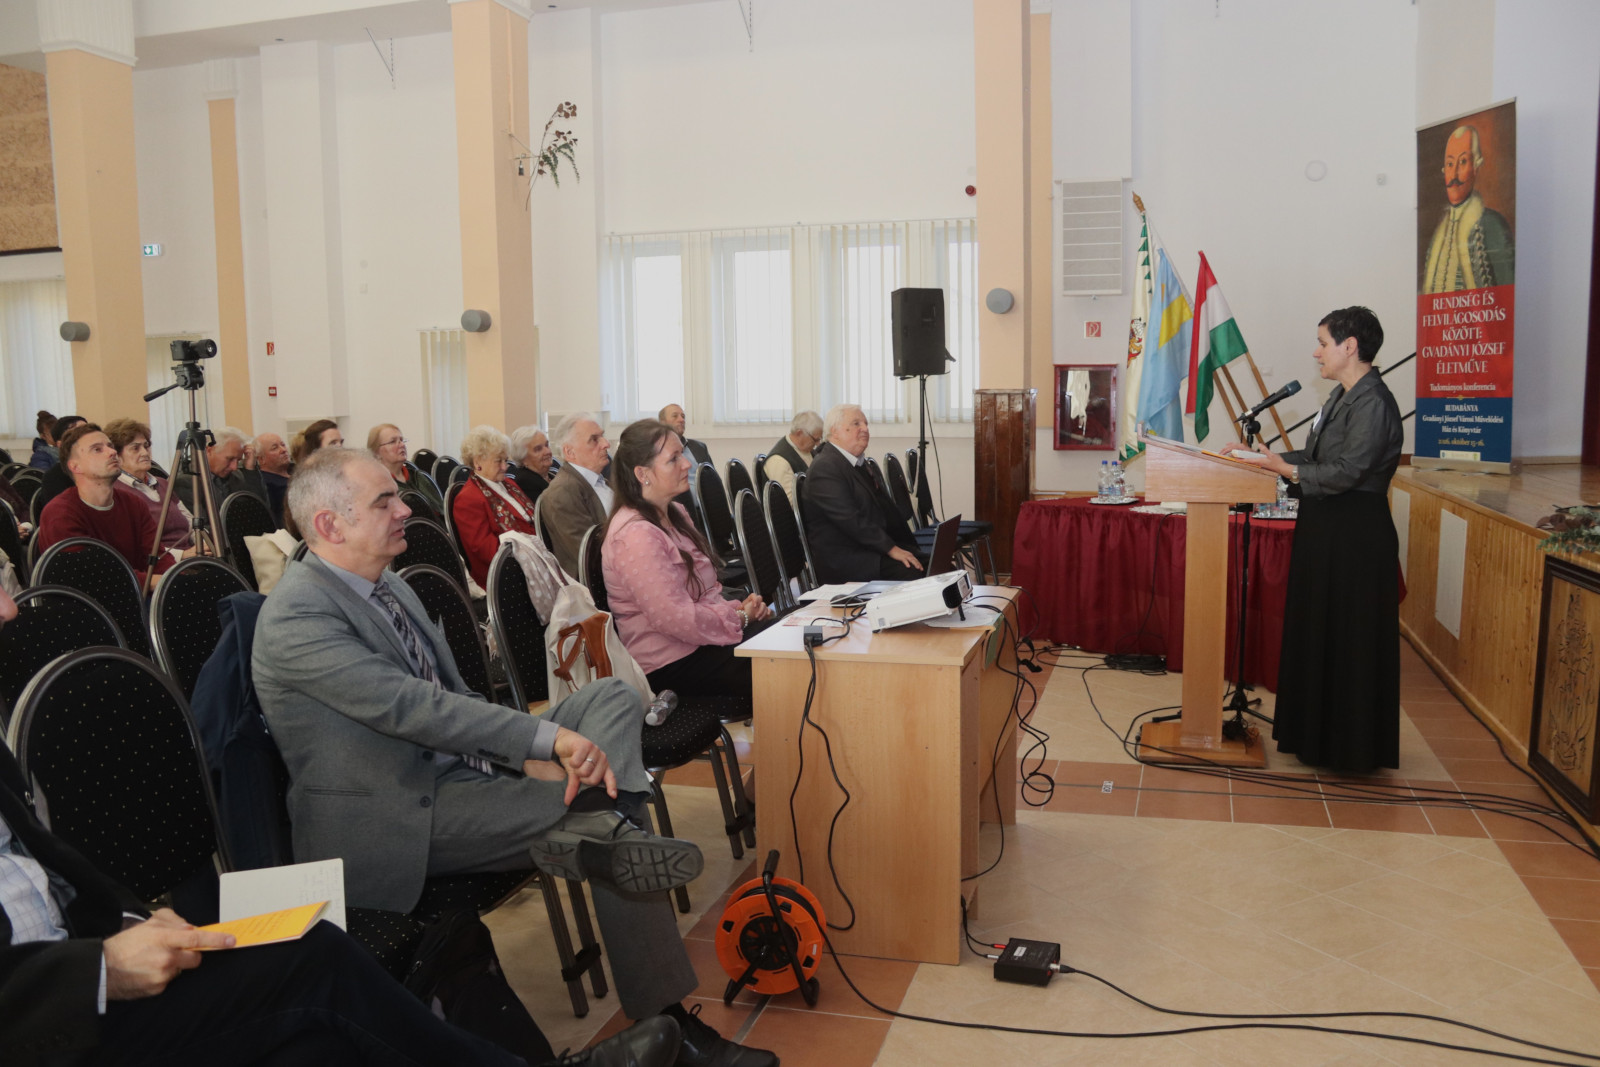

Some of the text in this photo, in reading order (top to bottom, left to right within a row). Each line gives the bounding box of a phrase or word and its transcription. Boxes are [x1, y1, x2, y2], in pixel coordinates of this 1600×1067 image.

[1433, 290, 1495, 310] RENDISÉG ÉS
[1422, 306, 1506, 327] FELVILÁGOSODÁS
[1442, 326, 1483, 341] KÖZÖTT:
[1421, 341, 1506, 358] GVADÁNYI JÓZSEF
[1436, 359, 1488, 374] ÉLETMŰVE
[1430, 382, 1496, 393] Tudományos konferencia
